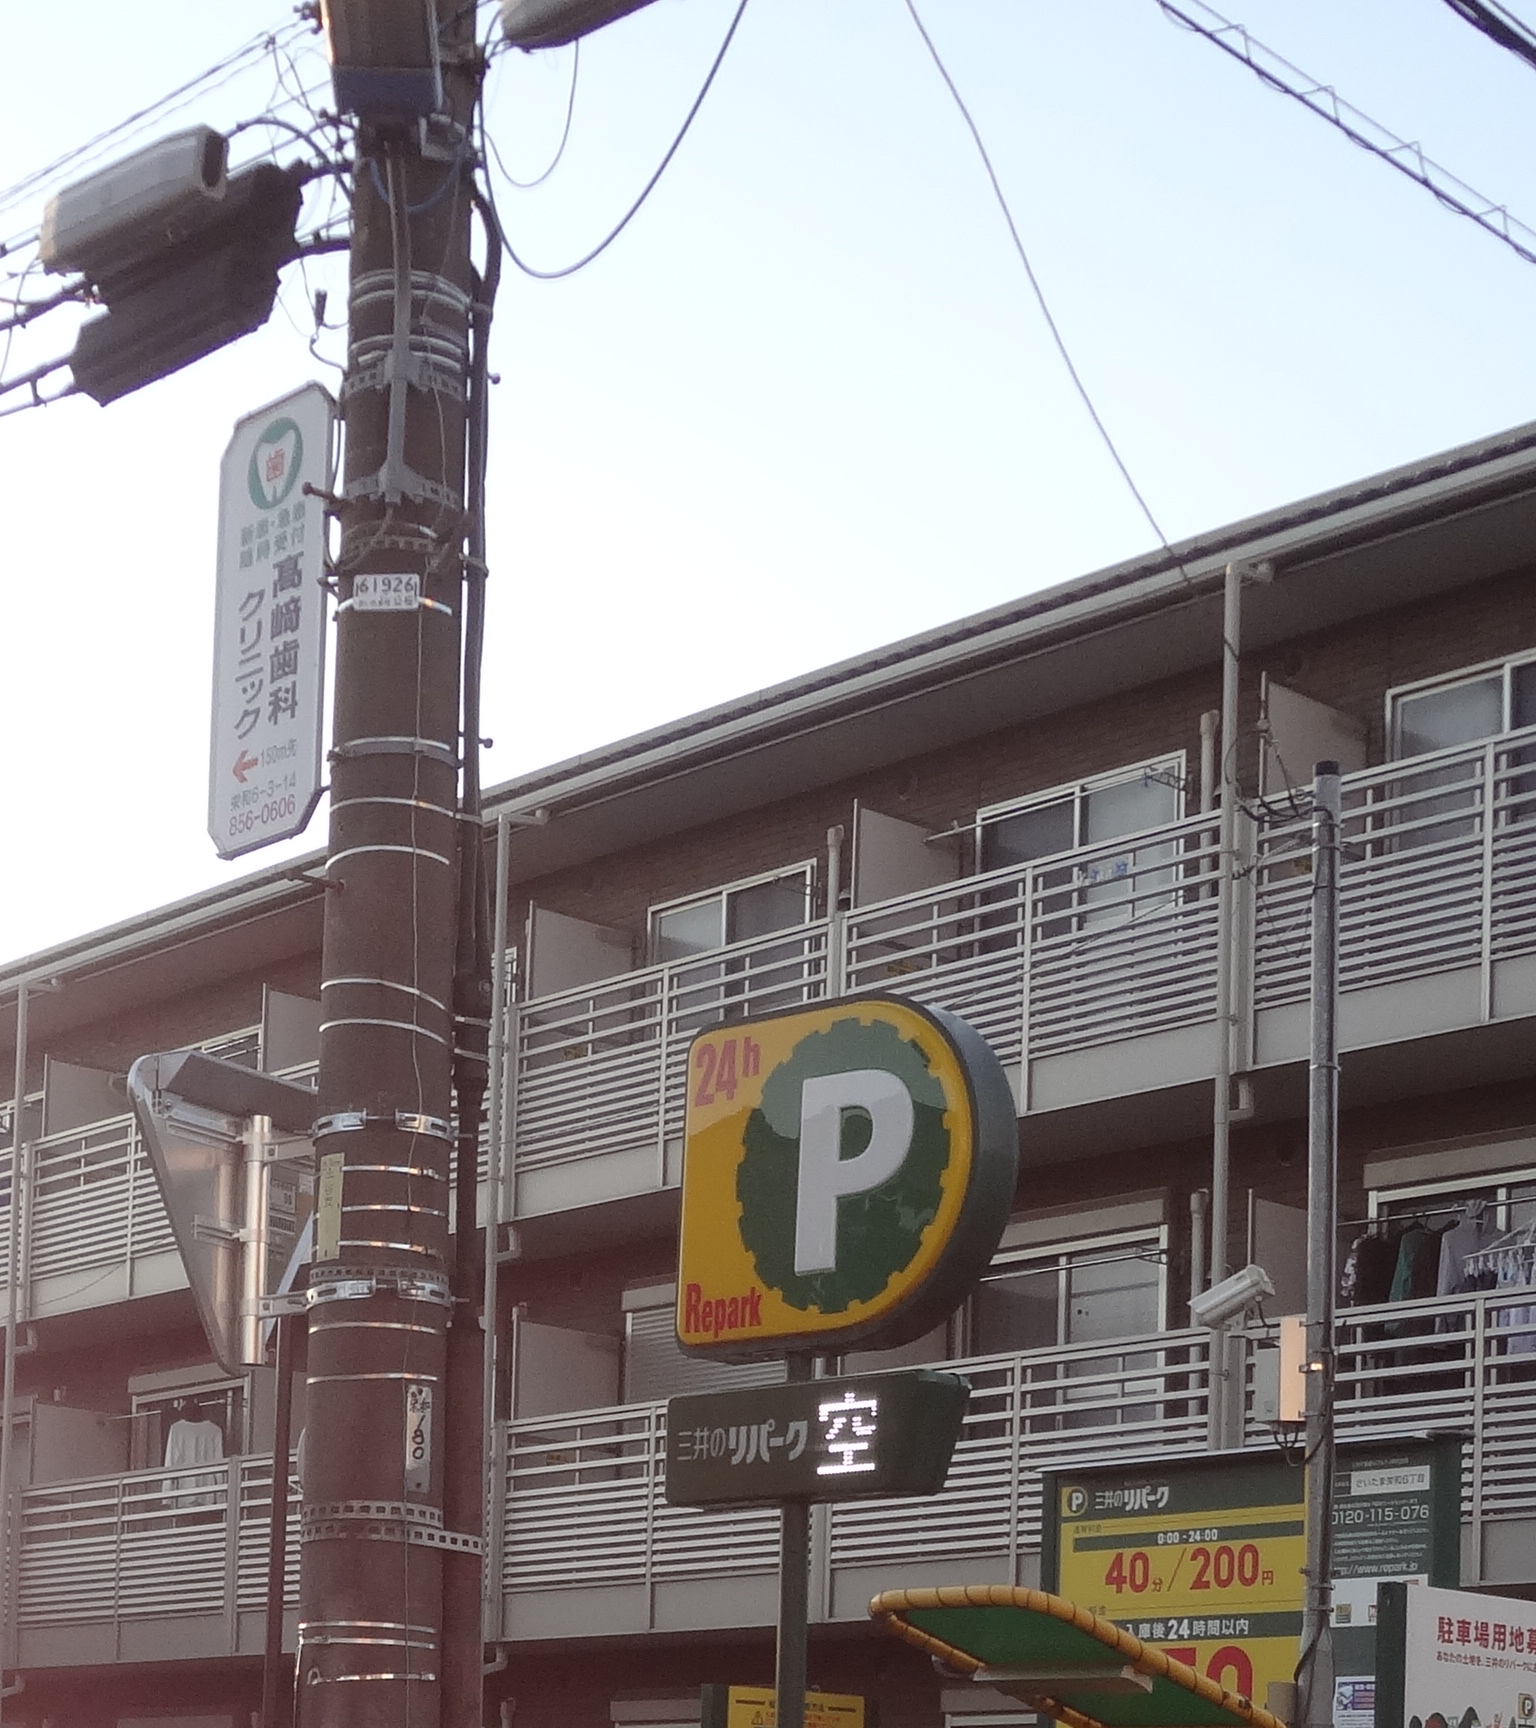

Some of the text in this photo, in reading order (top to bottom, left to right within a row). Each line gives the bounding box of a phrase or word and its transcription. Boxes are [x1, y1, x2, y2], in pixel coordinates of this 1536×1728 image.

[359, 577, 414, 593] 61926
[234, 588, 265, 740] クリニック
[229, 794, 296, 836] 856-0606
[694, 1036, 761, 1107] 24h
[795, 1069, 915, 1276] P
[684, 1283, 762, 1338] Repark
[677, 1419, 809, 1466] 三井のリパーク
[817, 1392, 877, 1476] 空
[1094, 1485, 1170, 1512] 三井のリパーク
